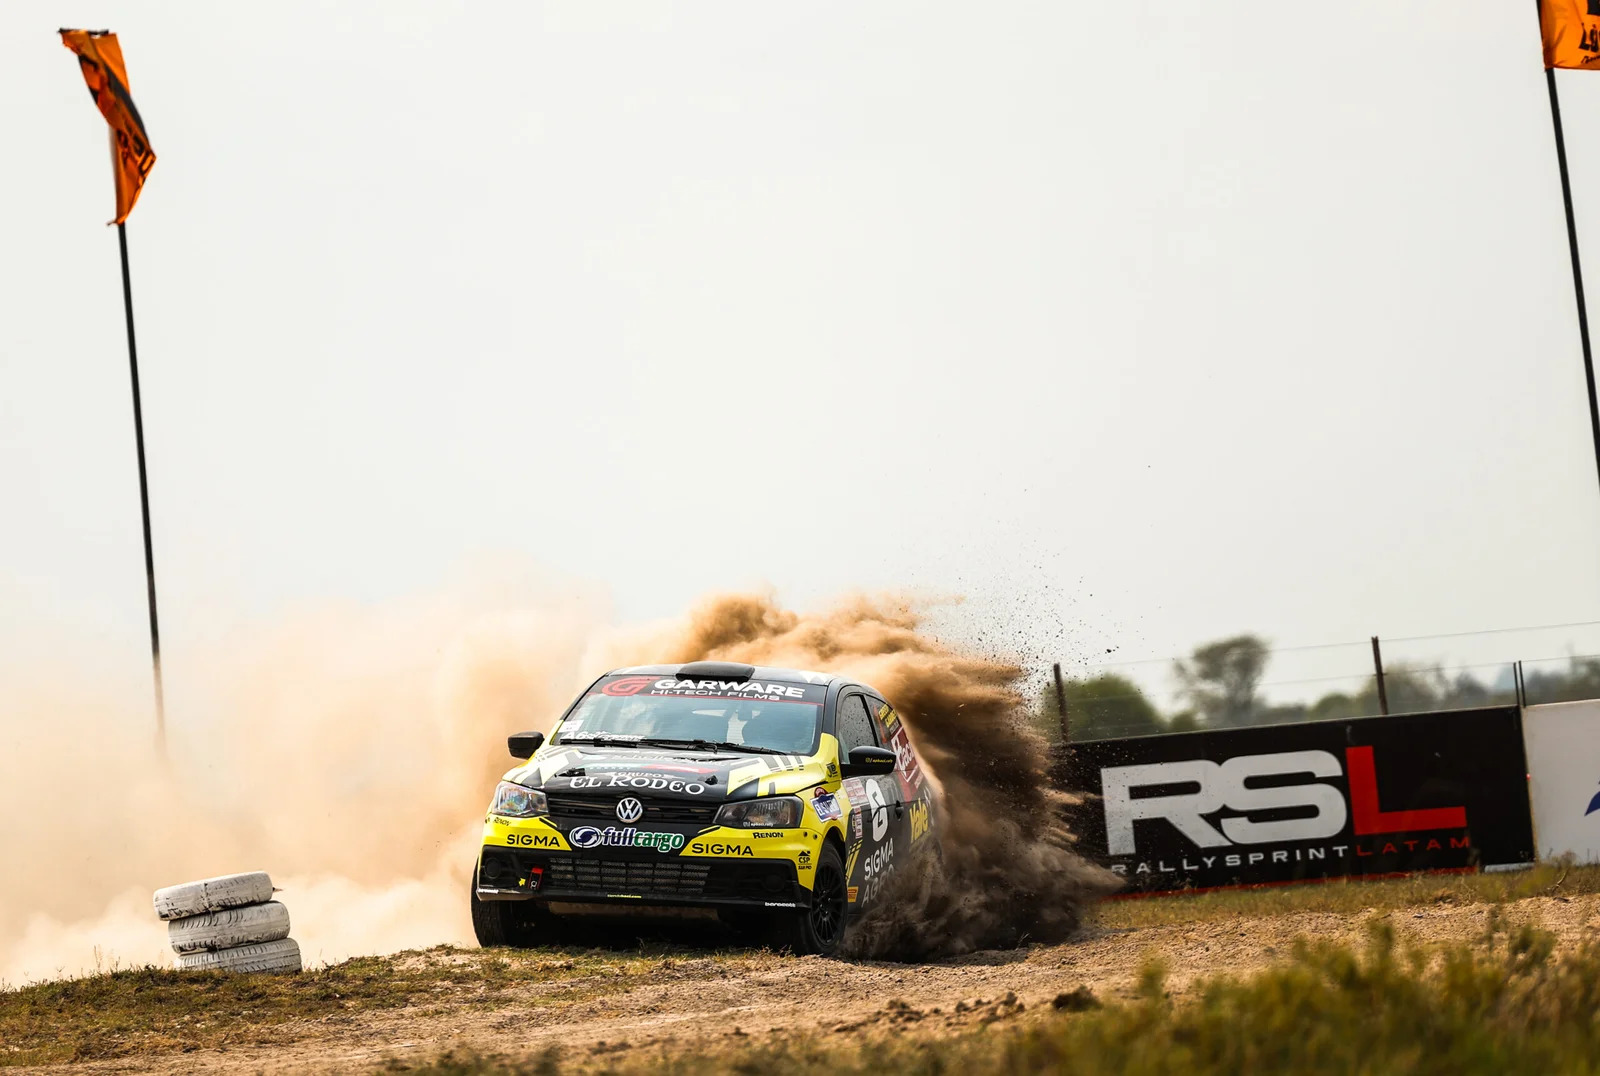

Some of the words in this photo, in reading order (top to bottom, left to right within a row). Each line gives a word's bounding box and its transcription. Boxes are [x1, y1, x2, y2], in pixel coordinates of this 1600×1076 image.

[650, 689, 731, 698] HI-TECH
[733, 691, 780, 701] FILMS
[654, 679, 805, 699] GARWARE
[569, 775, 602, 789] EL
[607, 775, 705, 795] RODEO
[1101, 745, 1467, 856] RSL
[909, 797, 928, 843] Yale
[506, 834, 560, 847] SIGMA
[602, 826, 685, 852] fullcargo
[752, 831, 784, 839] RENON
[691, 843, 754, 856] SIGMA
[864, 837, 894, 881] SIGMA
[1111, 845, 1349, 875] RALLYSPRINT
[1356, 834, 1471, 857] LATAM
